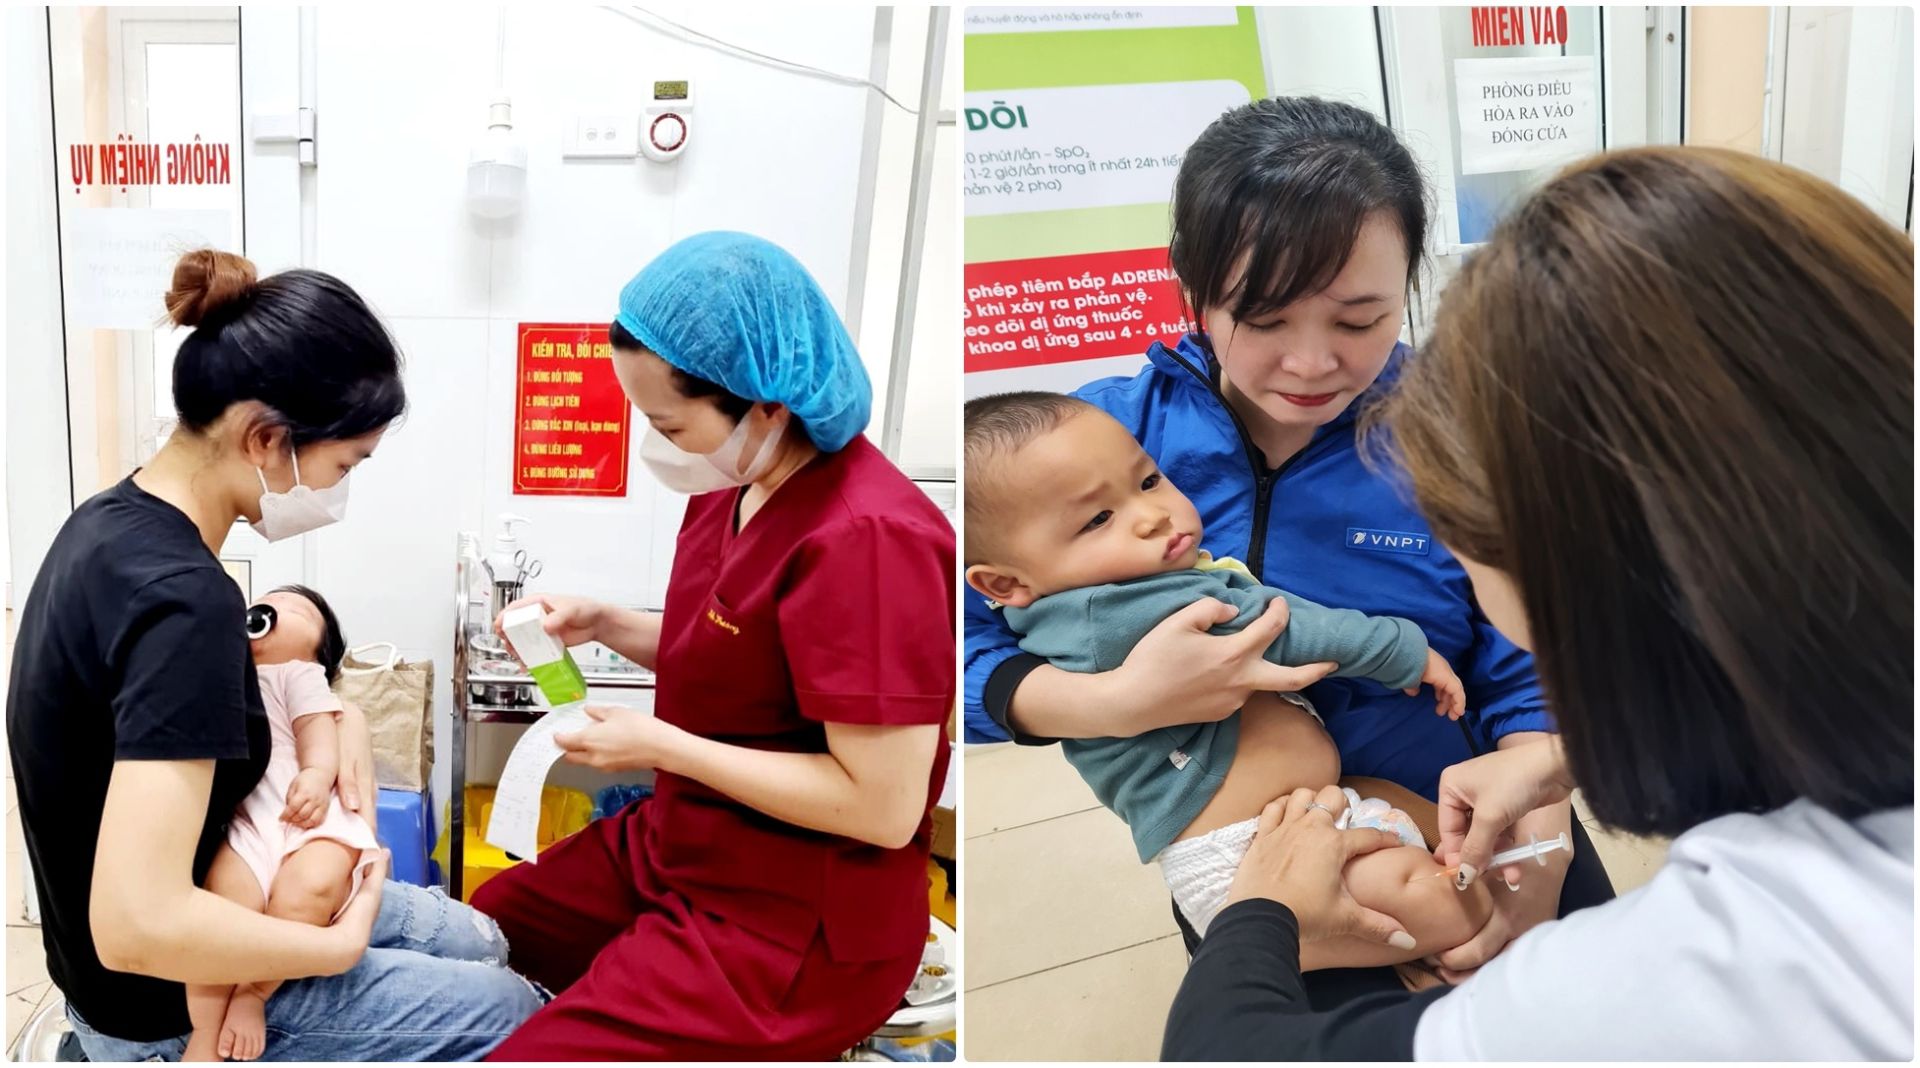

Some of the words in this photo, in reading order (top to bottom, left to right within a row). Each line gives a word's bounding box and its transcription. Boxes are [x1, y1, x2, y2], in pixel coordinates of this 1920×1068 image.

[1483, 81, 1534, 99] PHÒNG
[1538, 79, 1572, 97] ĐIỀU
[964, 100, 1028, 131] DÕI
[1483, 104, 1515, 121] HÒA
[1520, 106, 1539, 120] RA
[1543, 101, 1574, 118] VÀO
[1492, 126, 1534, 144] ĐÓNG
[1537, 123, 1568, 141] CỬA
[979, 147, 1041, 165] phút/lần
[994, 162, 1046, 181] giờ/lần
[1048, 160, 1086, 175] trong
[1100, 157, 1131, 171] nhất
[1135, 156, 1159, 169] 24h
[993, 181, 1012, 195] vệ
[1016, 181, 1025, 193] 2
[1028, 178, 1062, 194] pha)
[968, 282, 1018, 302] phép
[1022, 278, 1064, 294] tiêm
[1067, 271, 1106, 291] bắp
[976, 301, 1006, 317] khi
[1010, 297, 1045, 314] xảy
[1050, 298, 1070, 310] ra
[1074, 289, 1121, 311] phản
[1125, 288, 1153, 305] vệ.
[964, 324, 990, 338] eo
[994, 319, 1025, 334] dõi
[1030, 316, 1050, 333] dị
[1053, 313, 1088, 329] ứng
[1092, 305, 1144, 325] thuốc
[556, 342, 575, 361] TRA,
[576, 337, 592, 358] ĐỐI
[968, 341, 1017, 355] khoa
[1021, 335, 1042, 352] dị
[1044, 333, 1080, 348] ứng
[1084, 329, 1116, 343] sau
[1120, 326, 1133, 338] 4
[1146, 323, 1158, 337] 6
[1371, 534, 1426, 550] VNPT
